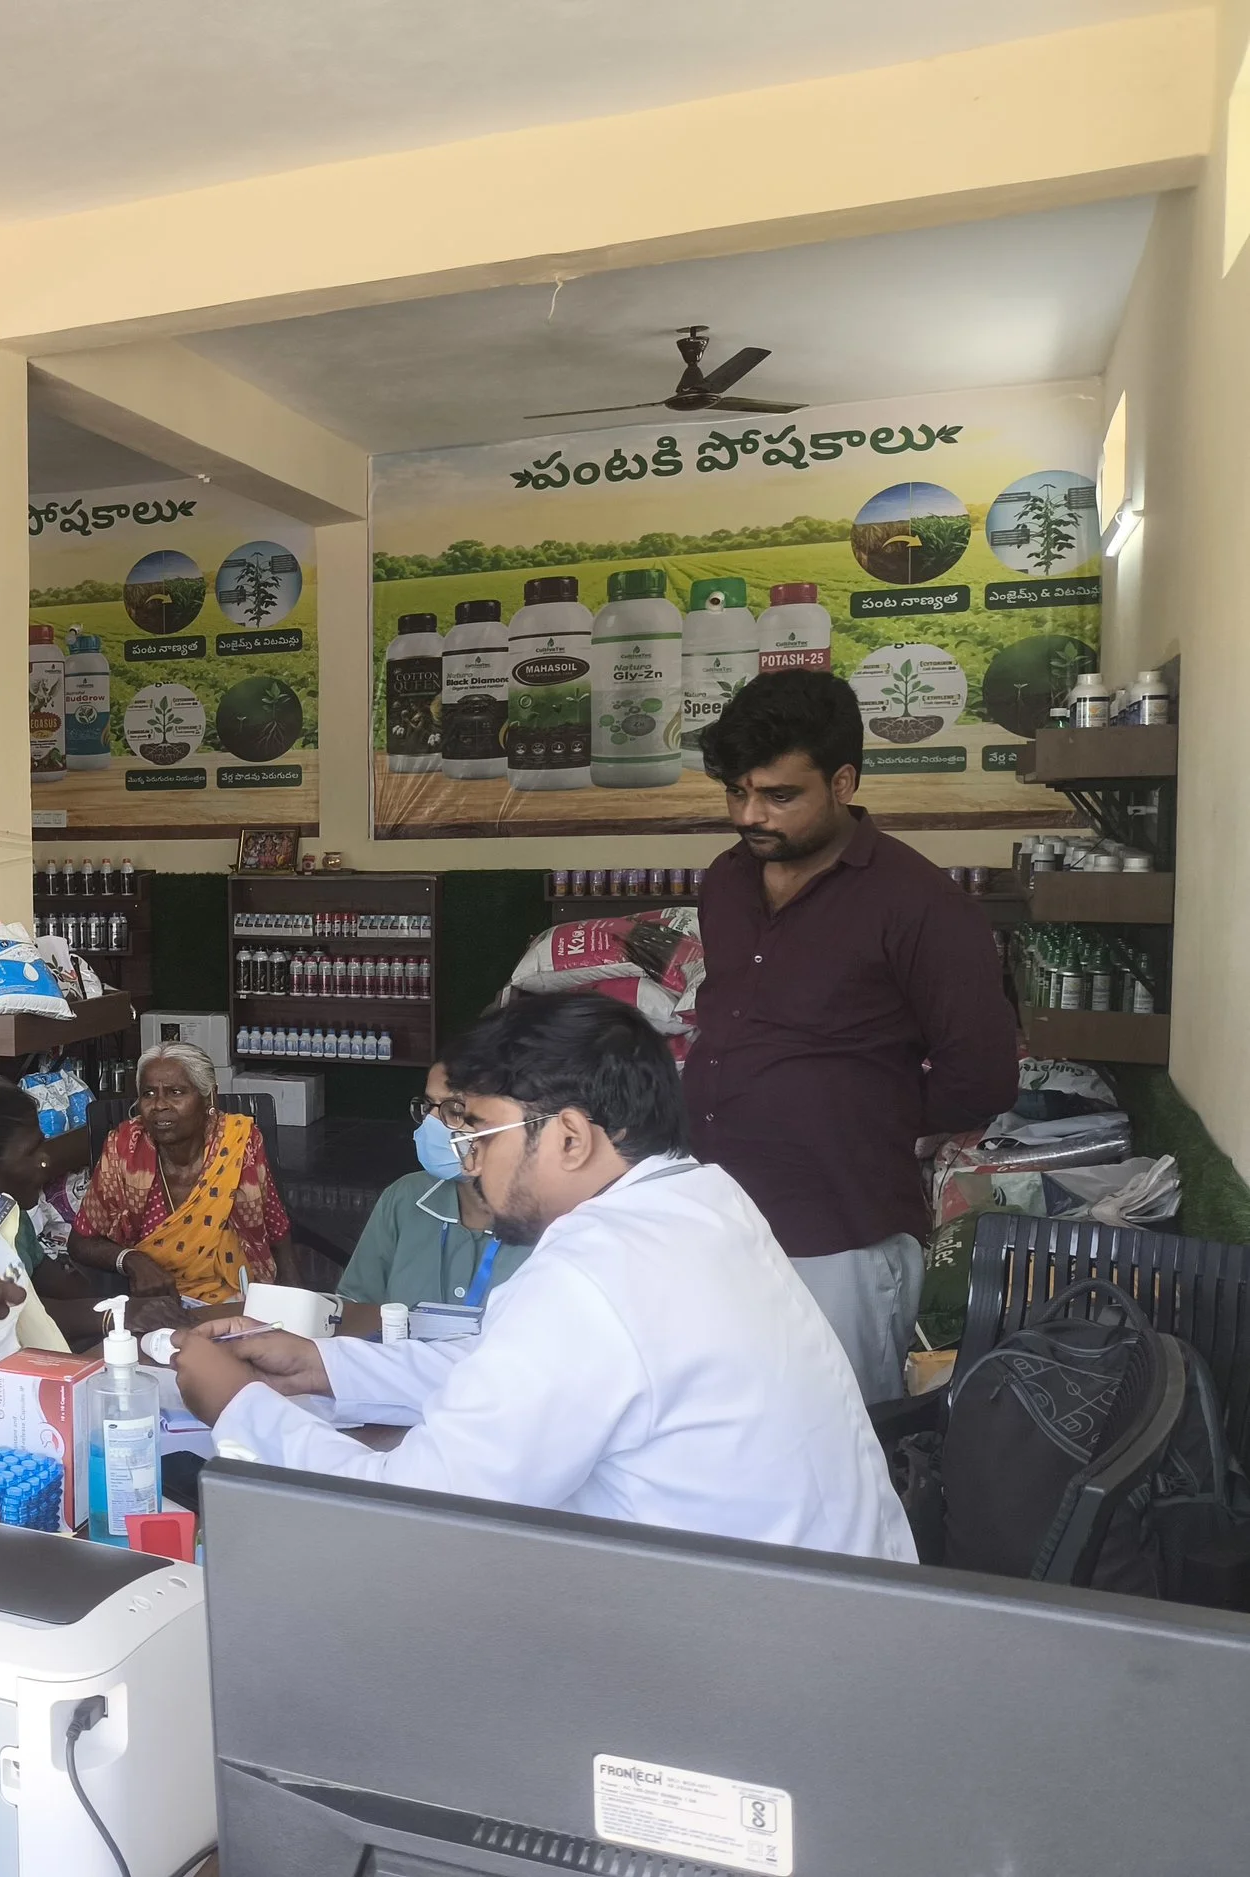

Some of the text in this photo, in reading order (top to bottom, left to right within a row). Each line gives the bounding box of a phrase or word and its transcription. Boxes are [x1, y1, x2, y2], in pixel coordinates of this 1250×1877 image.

[531, 423, 938, 490] పంటకి పోషకాలు
[1040, 590, 1051, 598] &
[861, 592, 958, 610] పంట నాణ్యత
[132, 641, 198, 656] పంట నాణ్యత
[761, 652, 824, 667] POTASH-25
[525, 663, 578, 674] MAHASOIL
[614, 664, 652, 672] Naturo
[396, 671, 440, 682] COTTON
[446, 678, 468, 686] Black
[613, 671, 663, 681] Gly-Zn
[393, 680, 441, 693] QUEEN
[684, 699, 722, 717] Spee
[30, 718, 57, 730] EGASUS
[600, 1763, 662, 1786] FRONTECH
